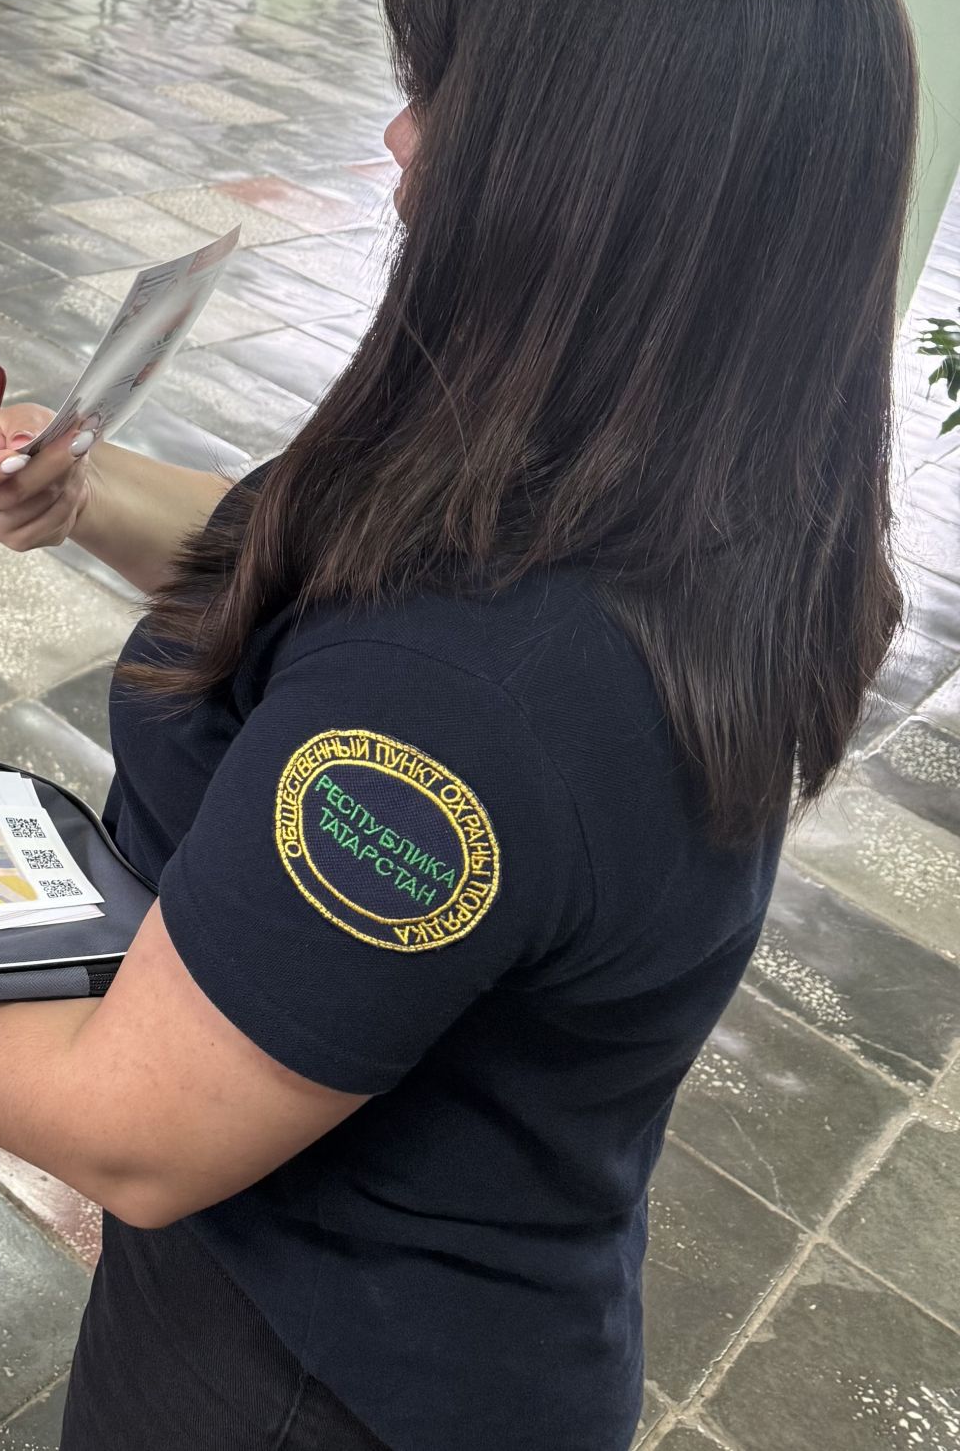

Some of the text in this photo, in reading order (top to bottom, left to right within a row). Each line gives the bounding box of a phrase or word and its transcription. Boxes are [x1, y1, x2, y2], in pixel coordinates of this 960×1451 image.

[278, 736, 493, 945] ОБЩЕСТВЕННЫЙ ПУНКТ ОХРАНЫ ПОРЯДКА
[313, 774, 457, 890] РЕСПУБЛИКА
[318, 807, 438, 906] ТАТАРСТАН
